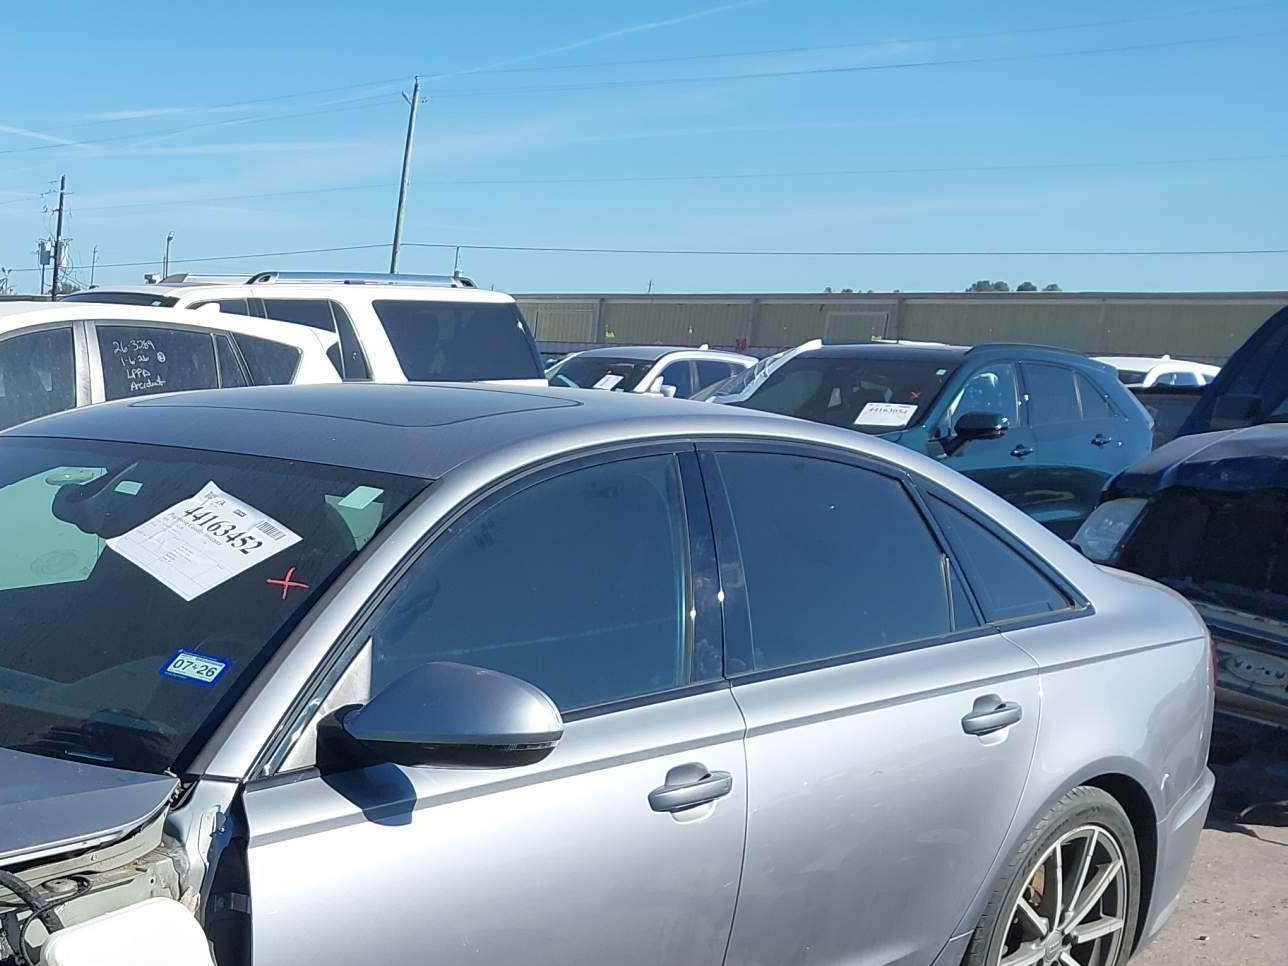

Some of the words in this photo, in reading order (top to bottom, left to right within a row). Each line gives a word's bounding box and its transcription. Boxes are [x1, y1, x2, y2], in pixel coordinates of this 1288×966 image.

[183, 506, 263, 555] 44163452
[172, 658, 194, 671] 07
[196, 664, 218, 677] 26
